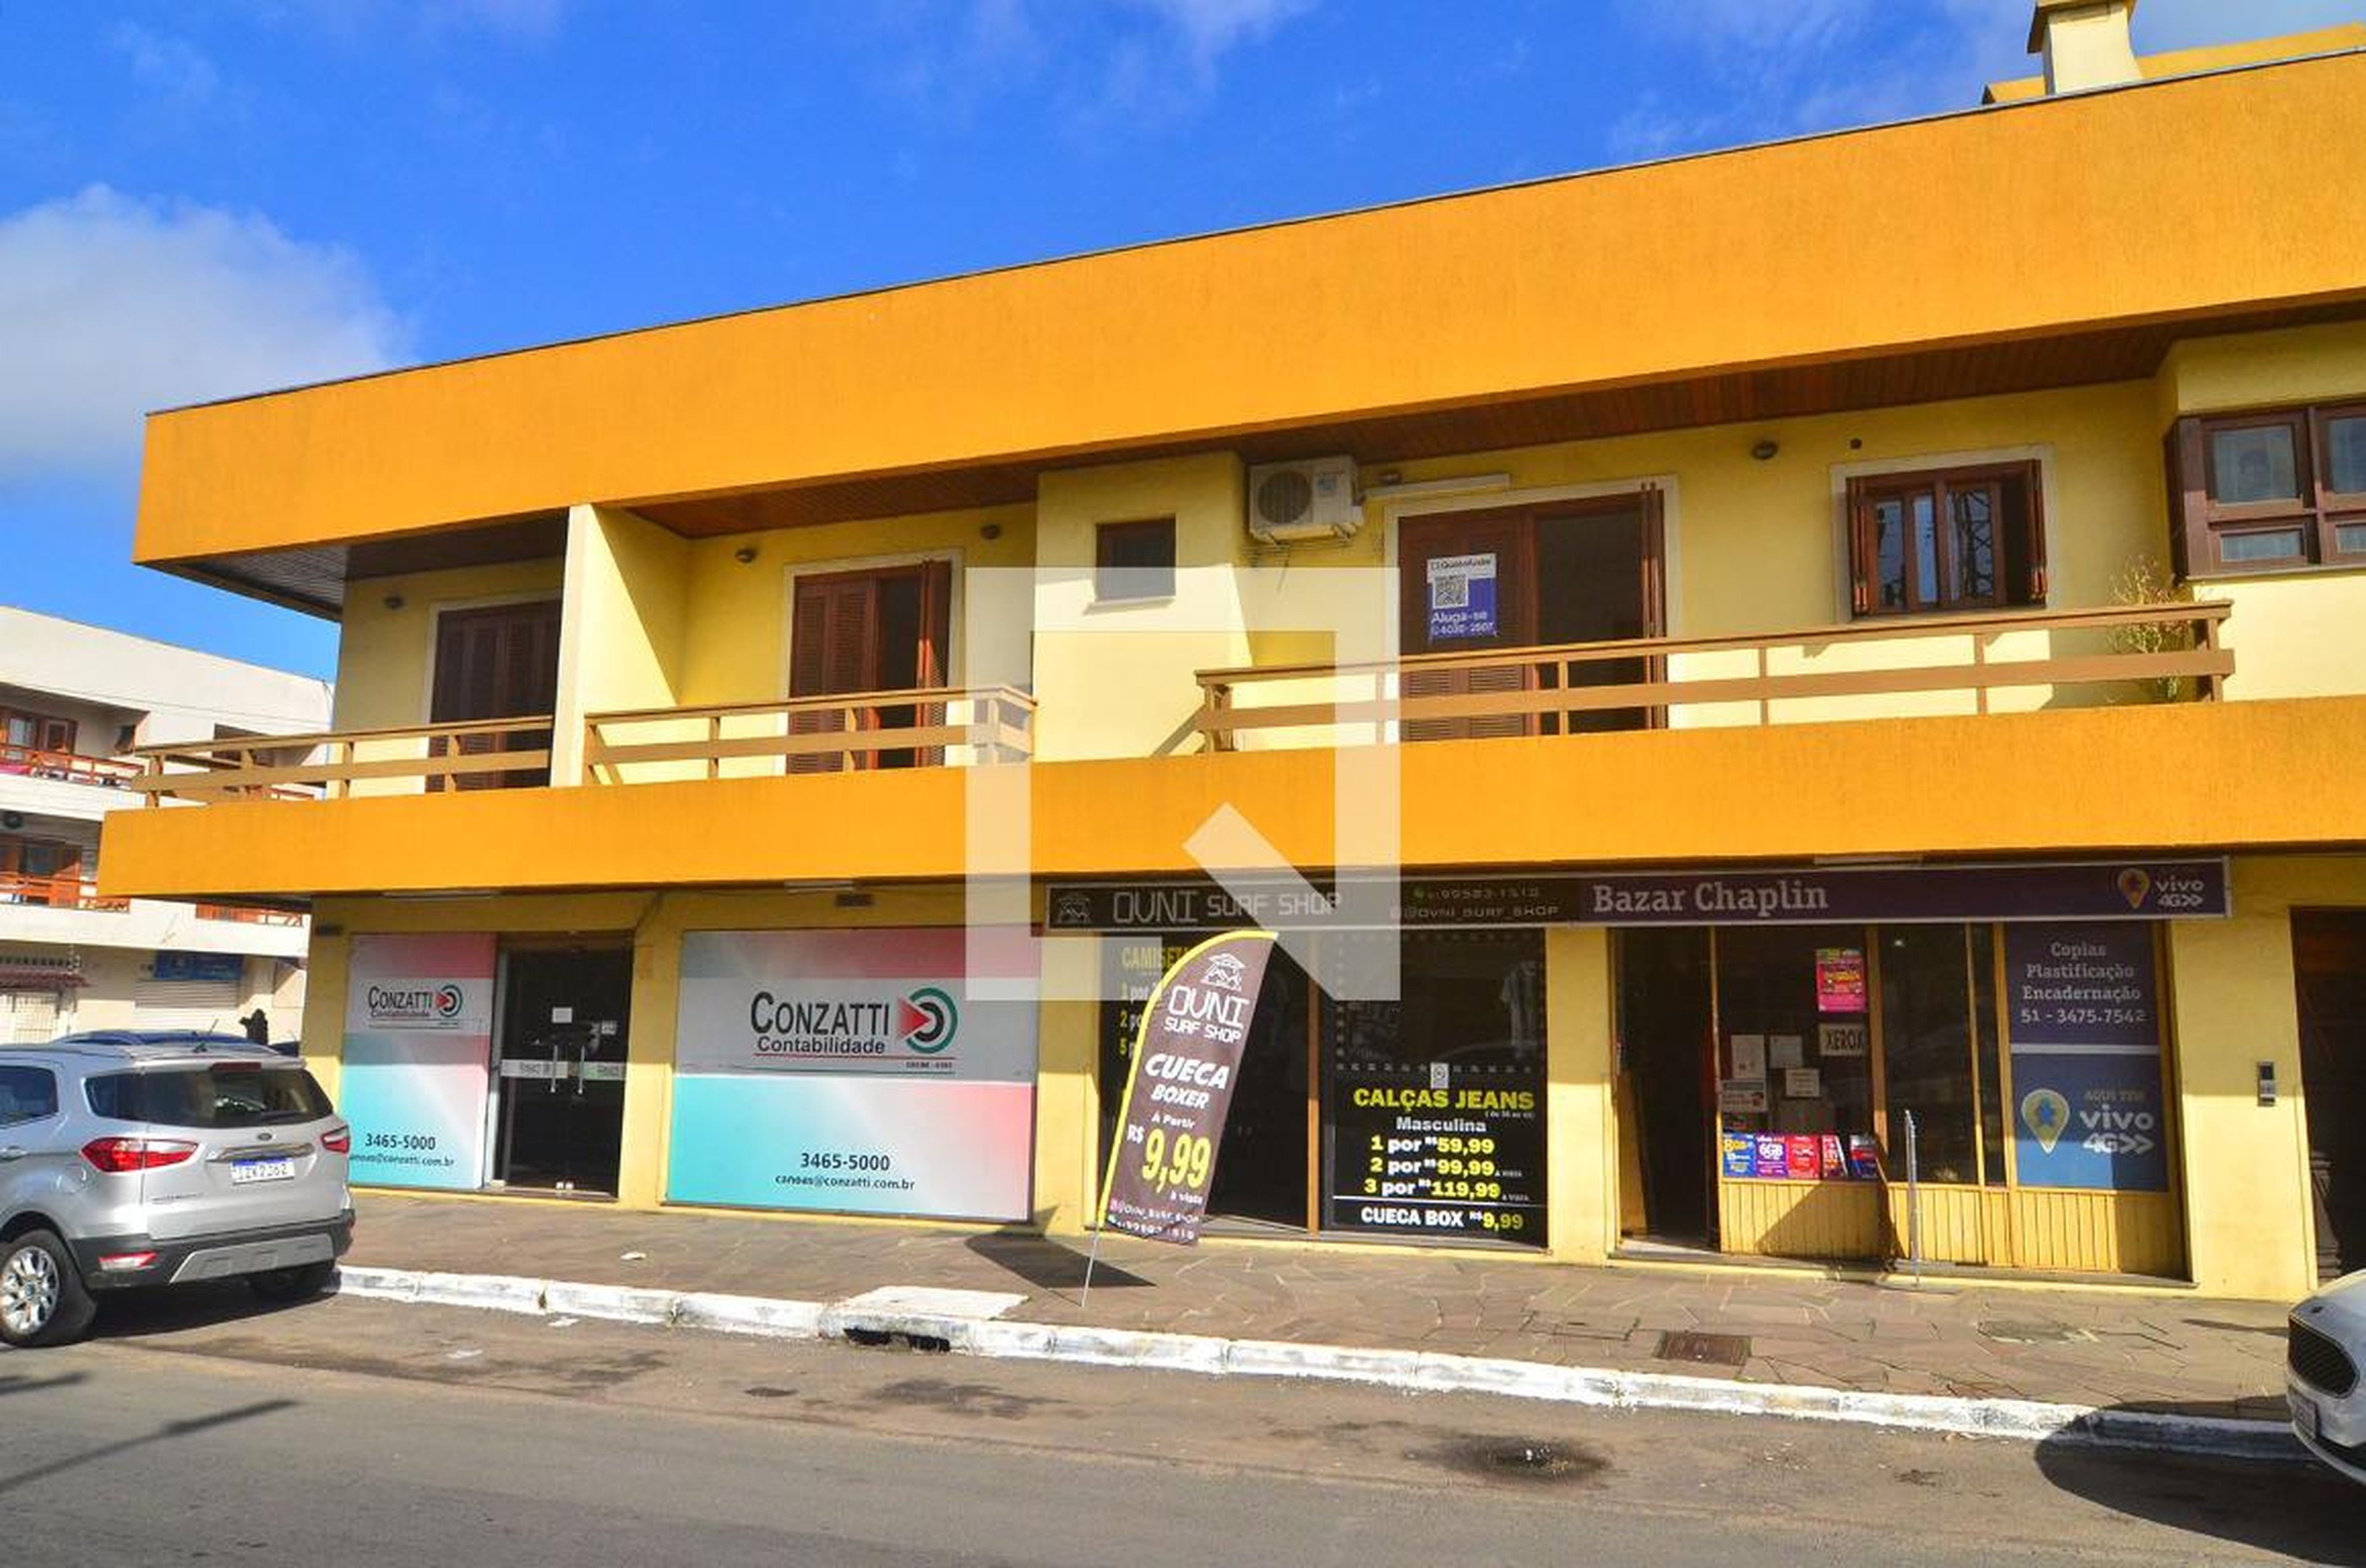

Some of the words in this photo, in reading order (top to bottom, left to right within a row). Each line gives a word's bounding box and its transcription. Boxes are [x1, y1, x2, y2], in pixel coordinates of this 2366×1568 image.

[2155, 875, 2205, 892] vivo
[1593, 885, 1686, 912] Bazar
[1694, 879, 1829, 916] Chaplin
[1113, 891, 1199, 923] OVNI
[1208, 893, 1269, 916] SURF
[1278, 893, 1341, 916] SHOP
[2025, 963, 2136, 980] Plastificação
[368, 986, 433, 1010] CONZATTI
[2022, 985, 2141, 1003] Encadernação
[750, 991, 890, 1036] CONZATTI
[1168, 985, 1250, 1030] OVNI
[2020, 1009, 2041, 1024] 51
[1120, 1009, 1128, 1028] 2
[1164, 1017, 1201, 1034] SURF
[1204, 1024, 1242, 1044] SHOP
[758, 1036, 885, 1054] Contabilidade
[1119, 1038, 1128, 1055] 5
[1145, 1053, 1230, 1089] CUECA
[1150, 1083, 1210, 1109] BOXER
[1354, 1088, 1449, 1111] CALÇAS
[1455, 1091, 1535, 1110] JEANS
[1163, 1114, 1196, 1129] Partir
[1396, 1116, 1487, 1132] Masculina
[2079, 1103, 2154, 1130] vivo
[365, 1132, 436, 1150] 3465-5000
[1370, 1135, 1384, 1151] 1
[1388, 1139, 1422, 1153] por
[800, 1153, 890, 1171] 3465-5000
[1126, 1124, 1144, 1144] R$
[1142, 1127, 1211, 1193] 9,99
[1370, 1158, 1383, 1173] 2
[1388, 1160, 1421, 1175] por
[774, 1174, 915, 1192] canoas@conzatti.com.br
[1364, 1179, 1378, 1194] 3
[1381, 1182, 1416, 1197] por
[1360, 1206, 1421, 1225] CUECA
[1425, 1209, 1465, 1227] BOX
